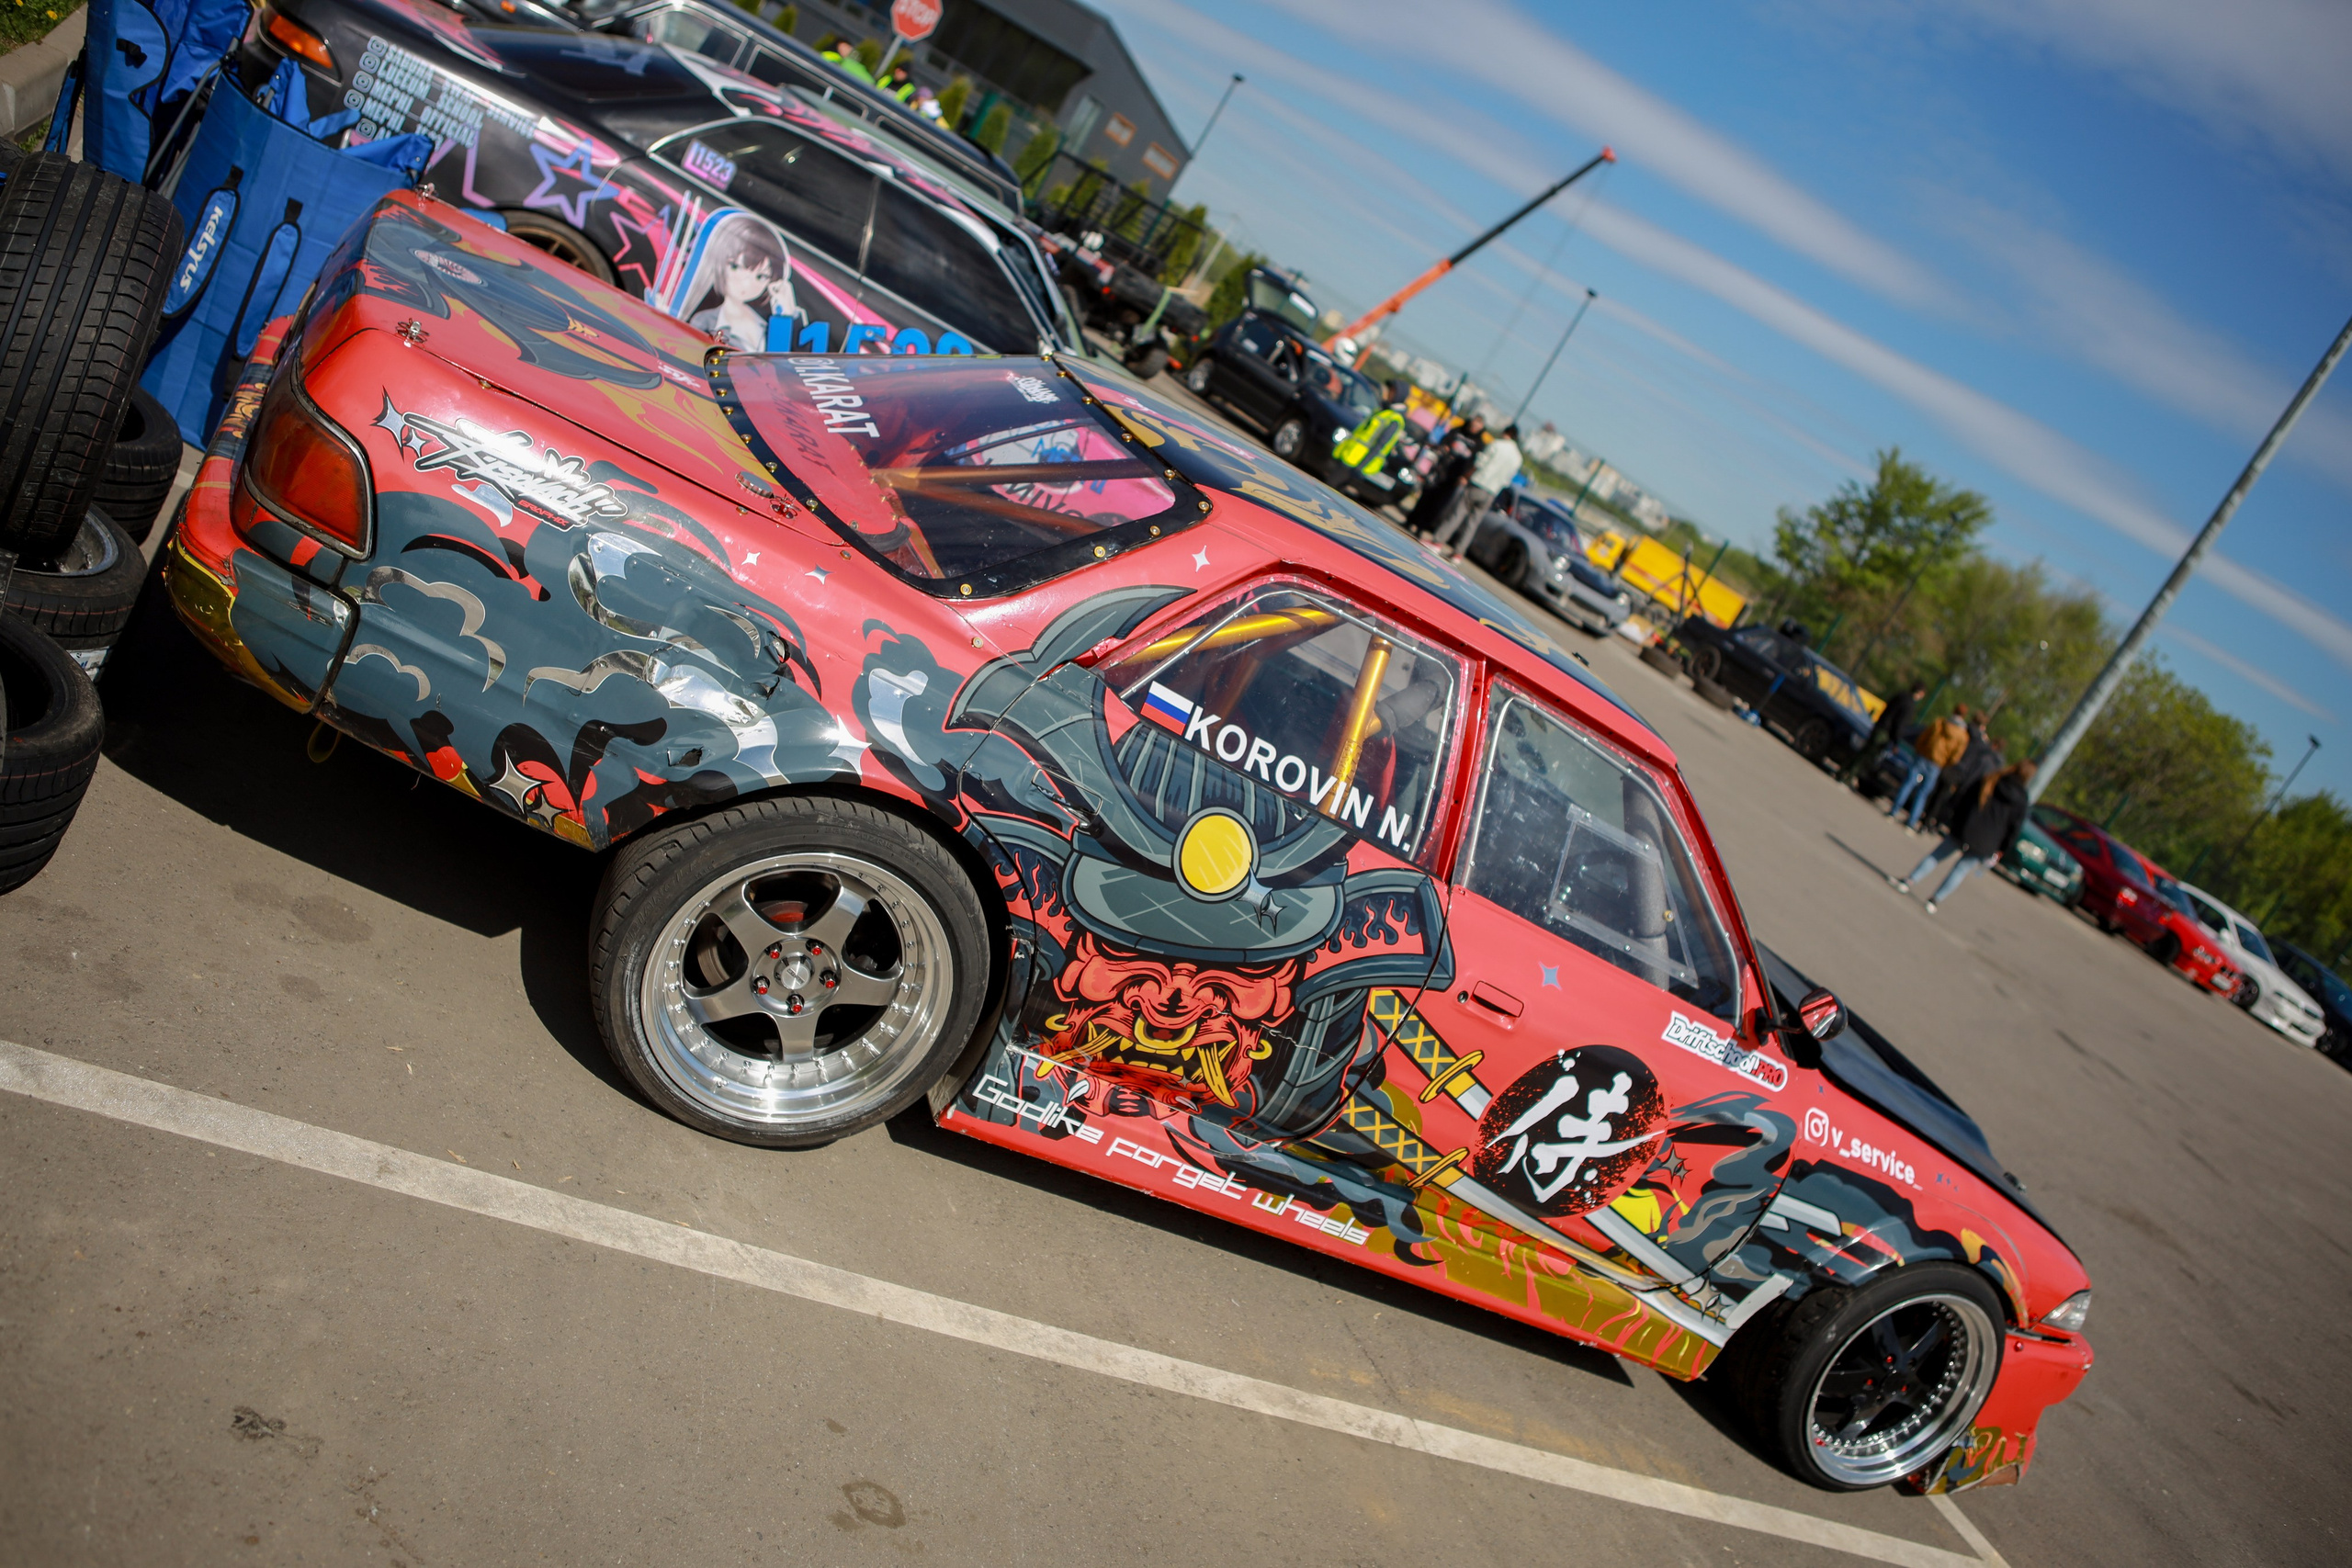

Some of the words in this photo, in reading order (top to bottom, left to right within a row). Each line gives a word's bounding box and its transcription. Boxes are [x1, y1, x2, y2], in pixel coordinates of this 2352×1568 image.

[1184, 705, 1374, 829] KOROVIN
[1377, 805, 1412, 852] N.
[972, 1073, 1105, 1145] Godlike
[1251, 1193, 1370, 1246] wheels
